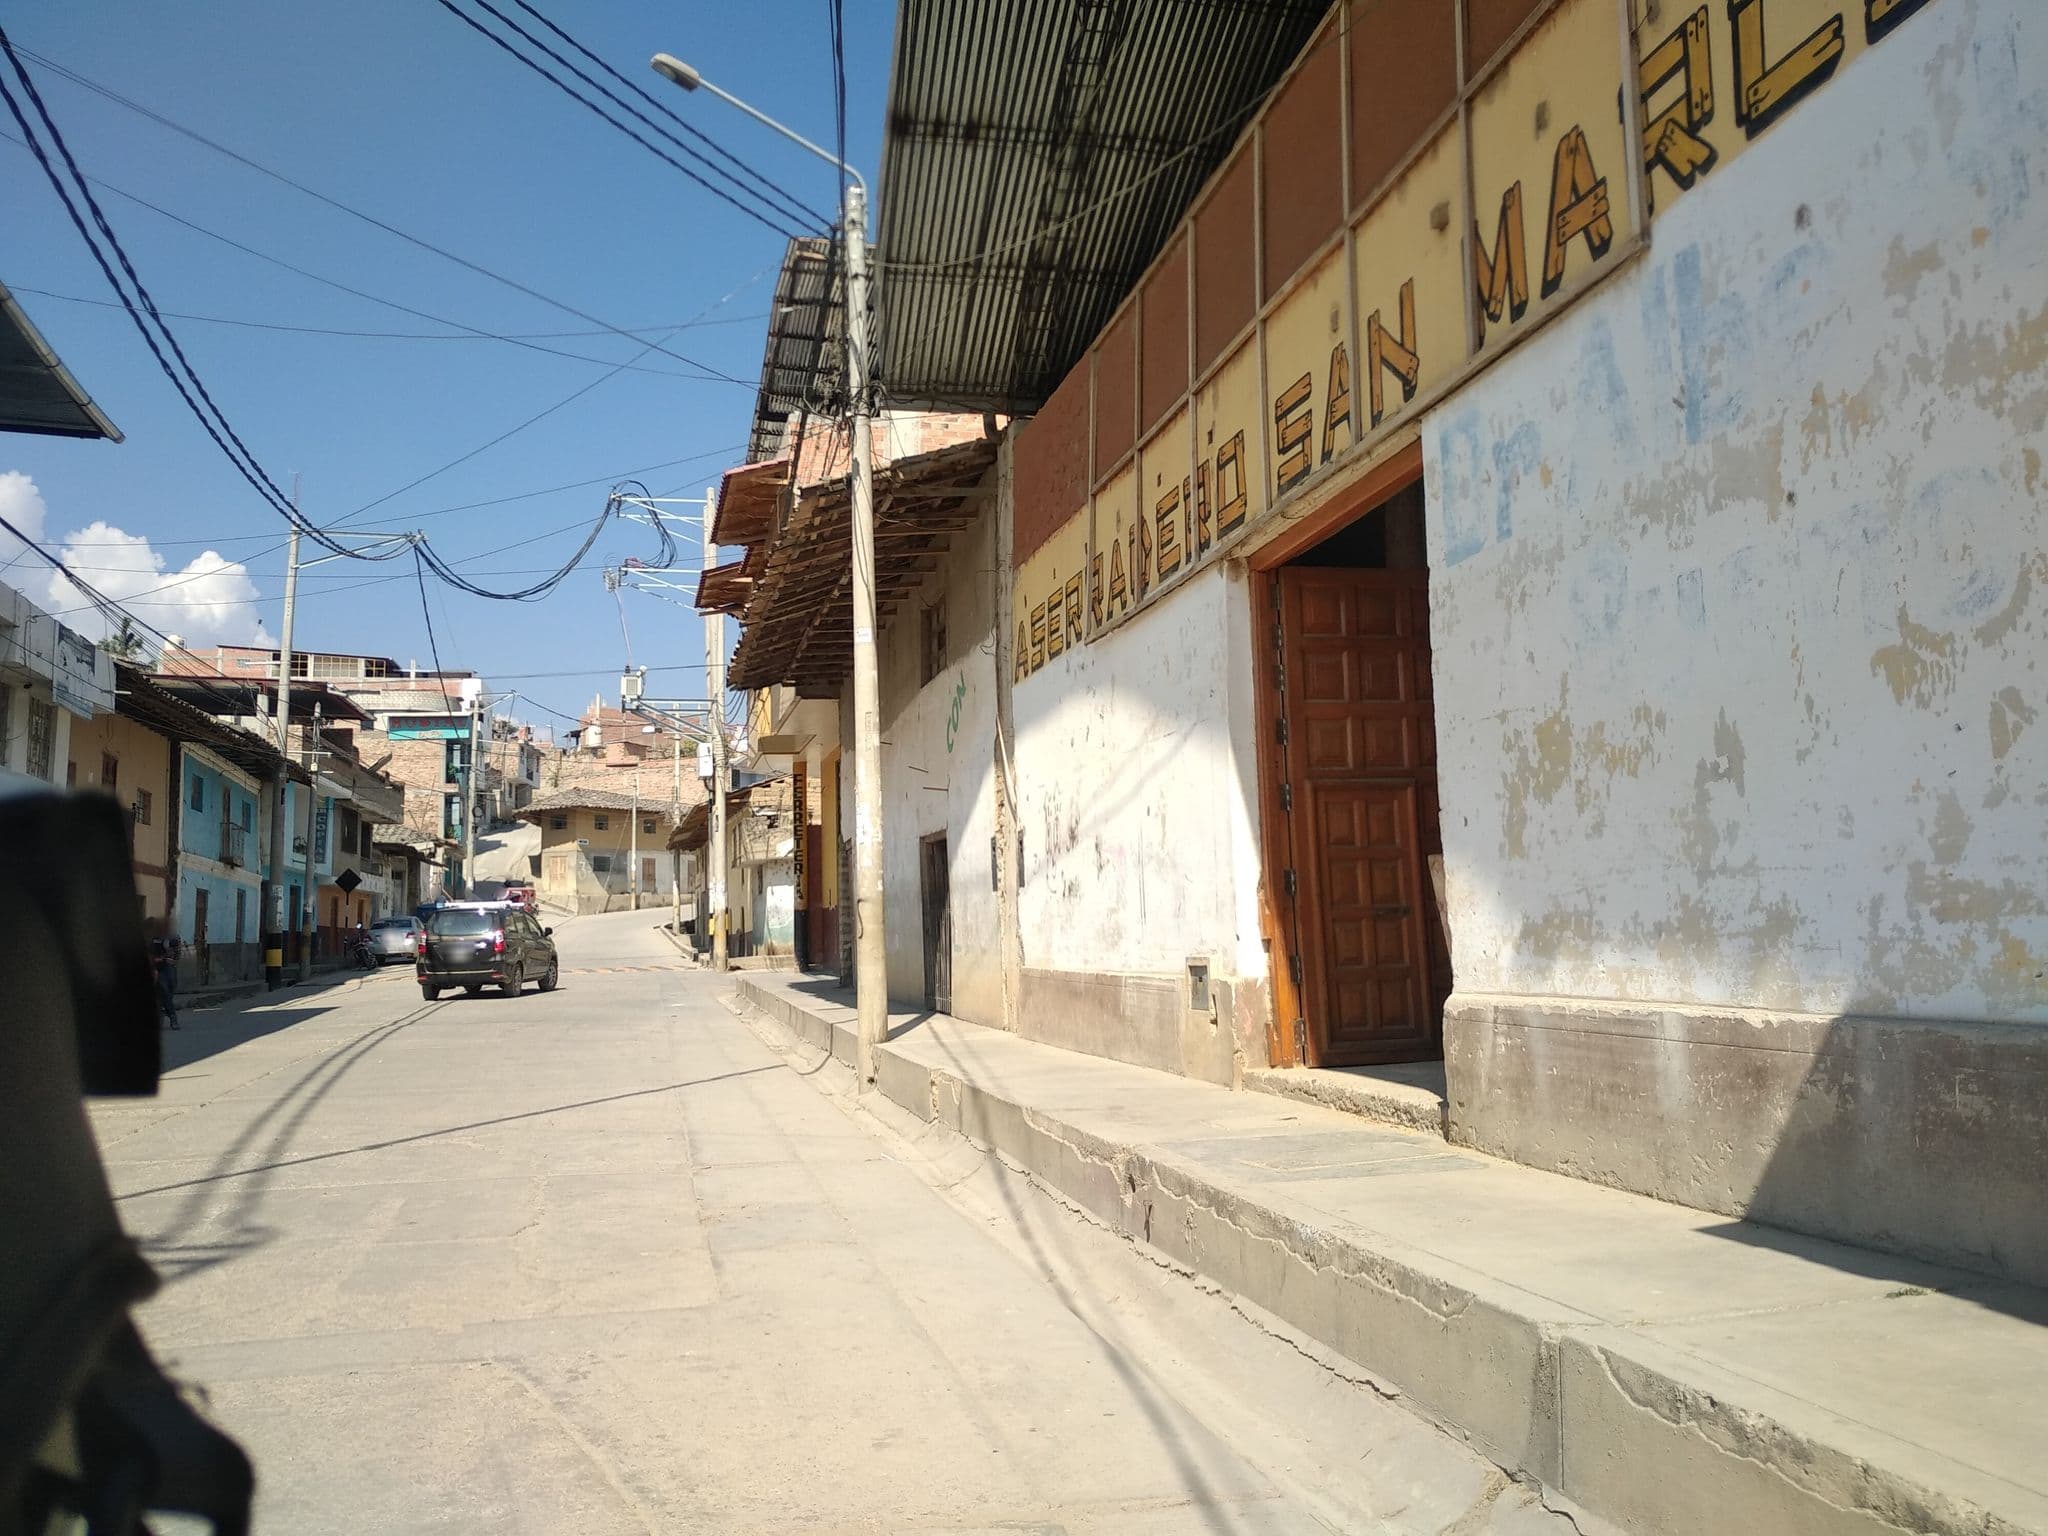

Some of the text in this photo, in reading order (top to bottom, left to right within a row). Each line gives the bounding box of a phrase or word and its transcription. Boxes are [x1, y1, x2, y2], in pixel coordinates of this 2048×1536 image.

[1014, 429, 1248, 684] ASERRADERO
[1275, 276, 1419, 496] SAN
[947, 668, 966, 753] CON
